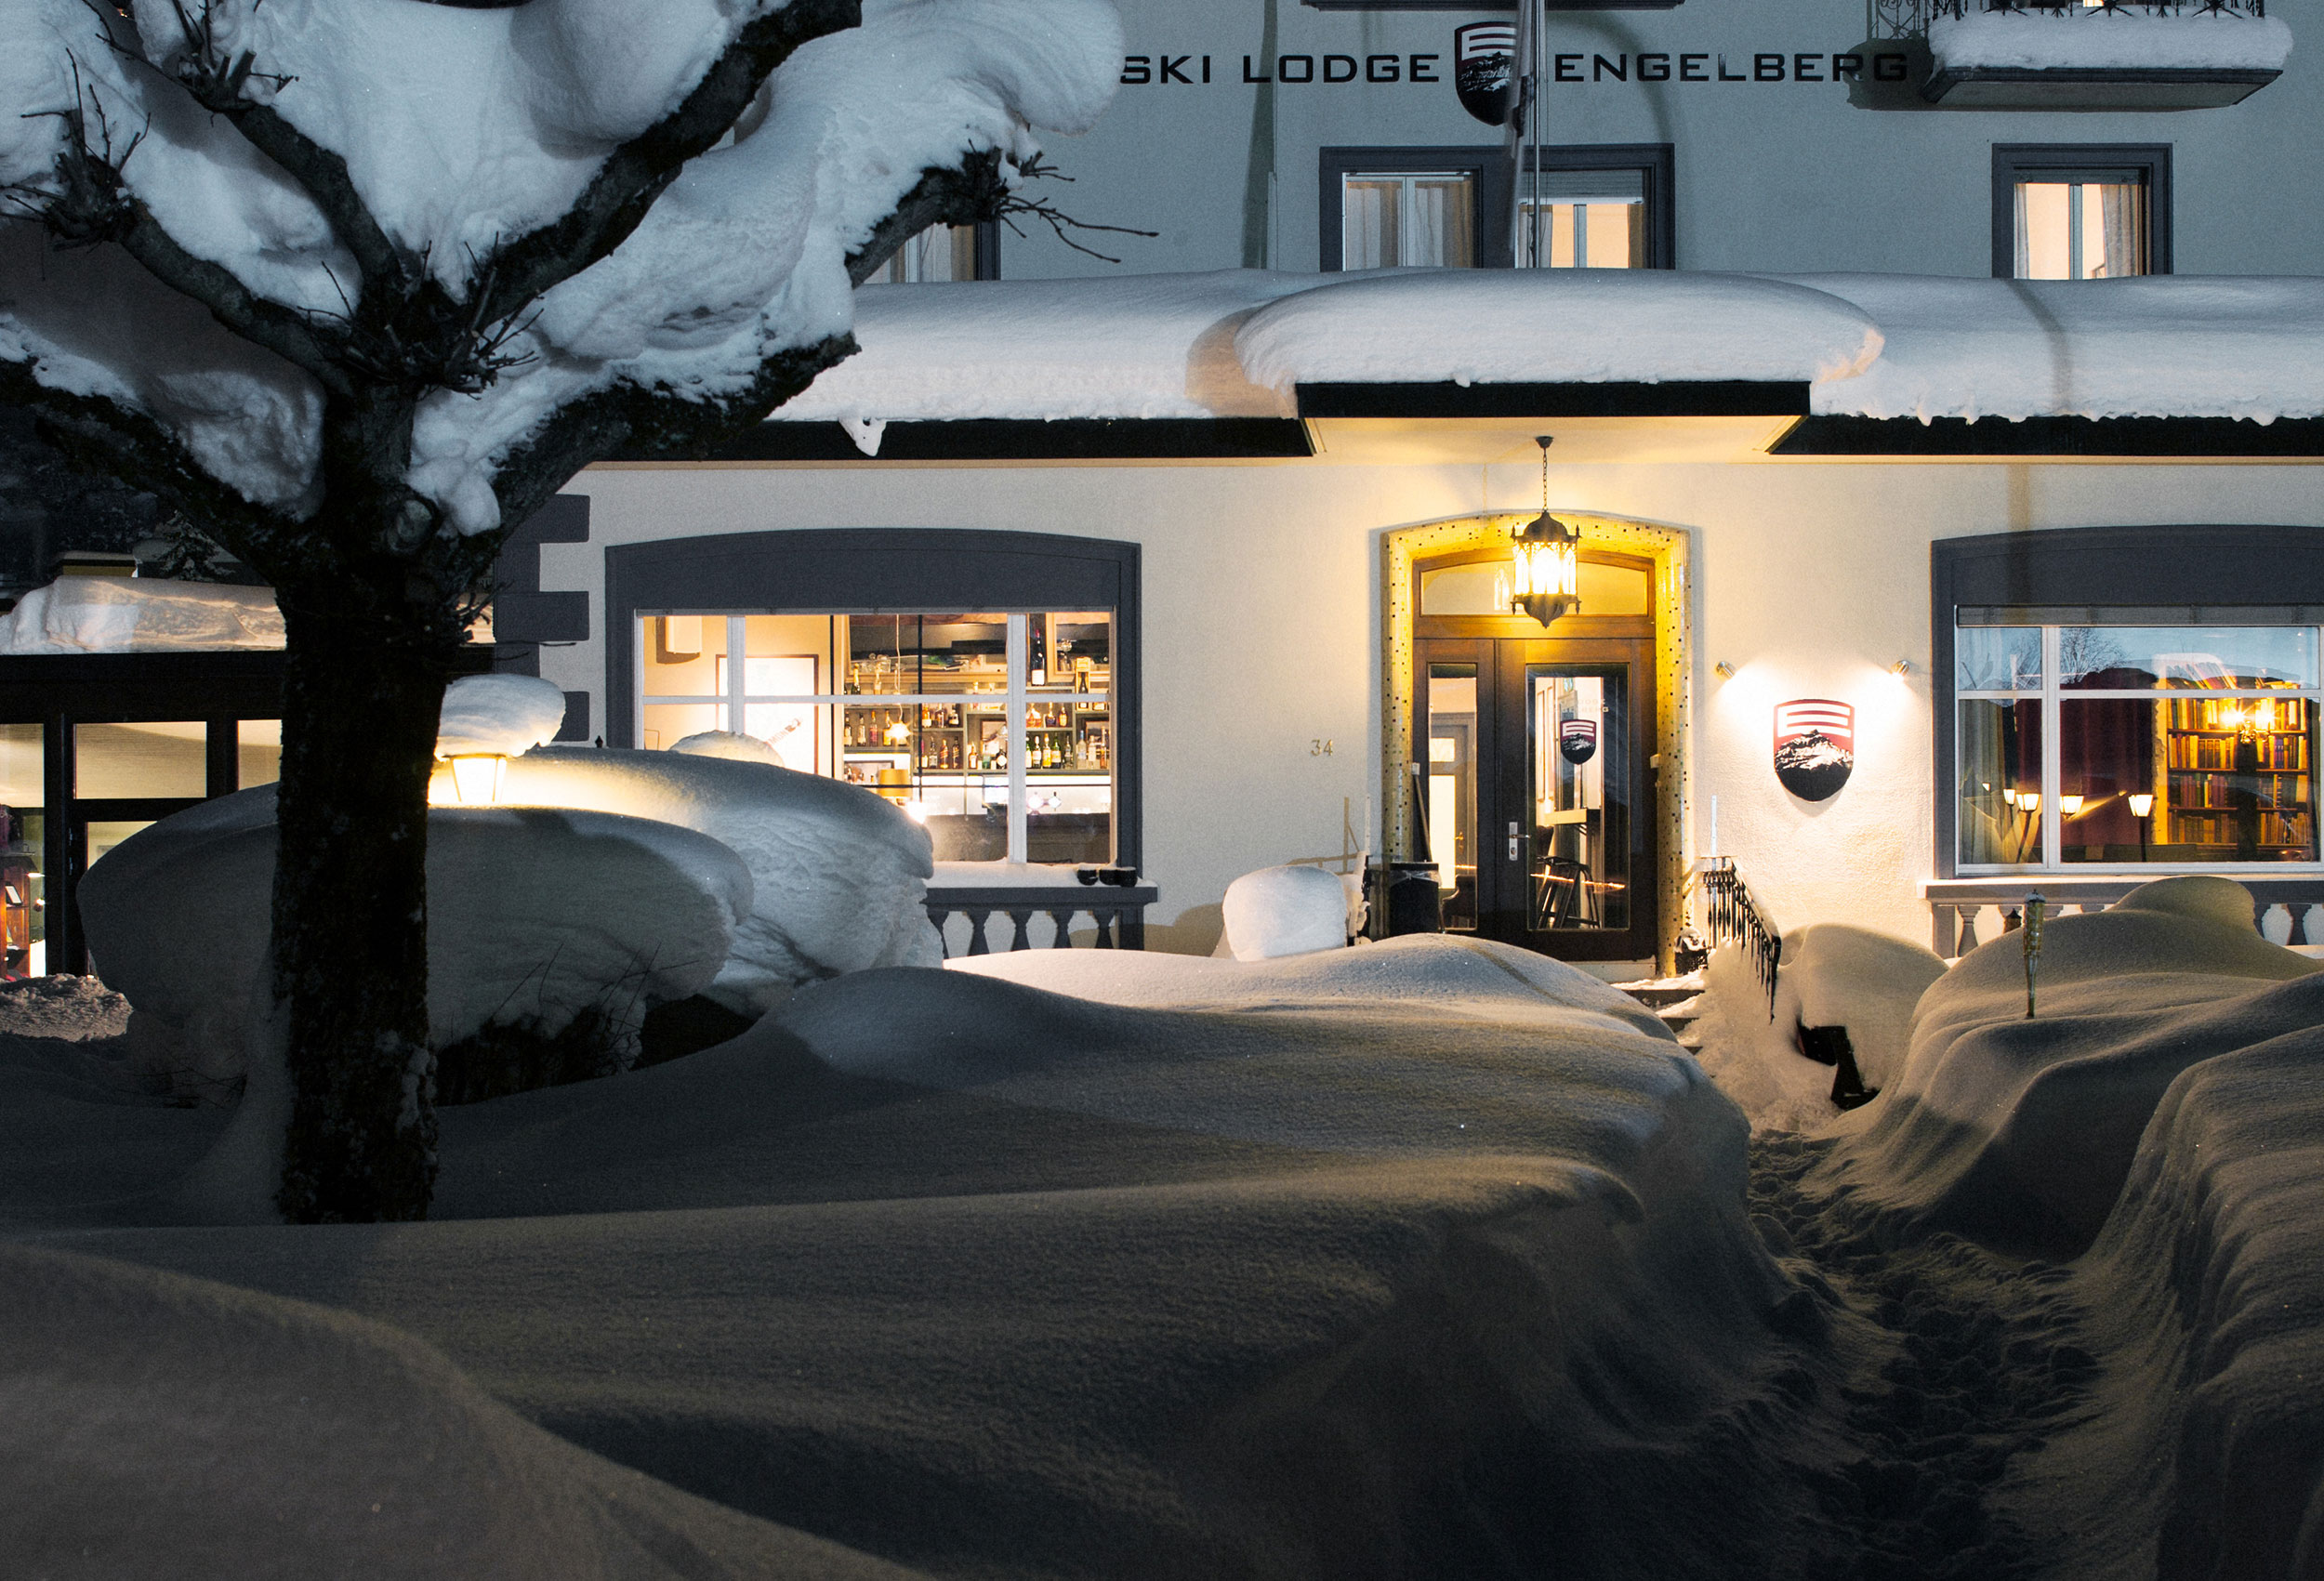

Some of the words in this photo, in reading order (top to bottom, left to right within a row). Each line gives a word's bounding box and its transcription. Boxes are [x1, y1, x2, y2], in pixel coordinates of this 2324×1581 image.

[1119, 55, 1211, 85] SKI
[1243, 54, 1440, 84] LODGE
[1554, 53, 1908, 83] ENGELBERG
[1310, 738, 1333, 757] 34
